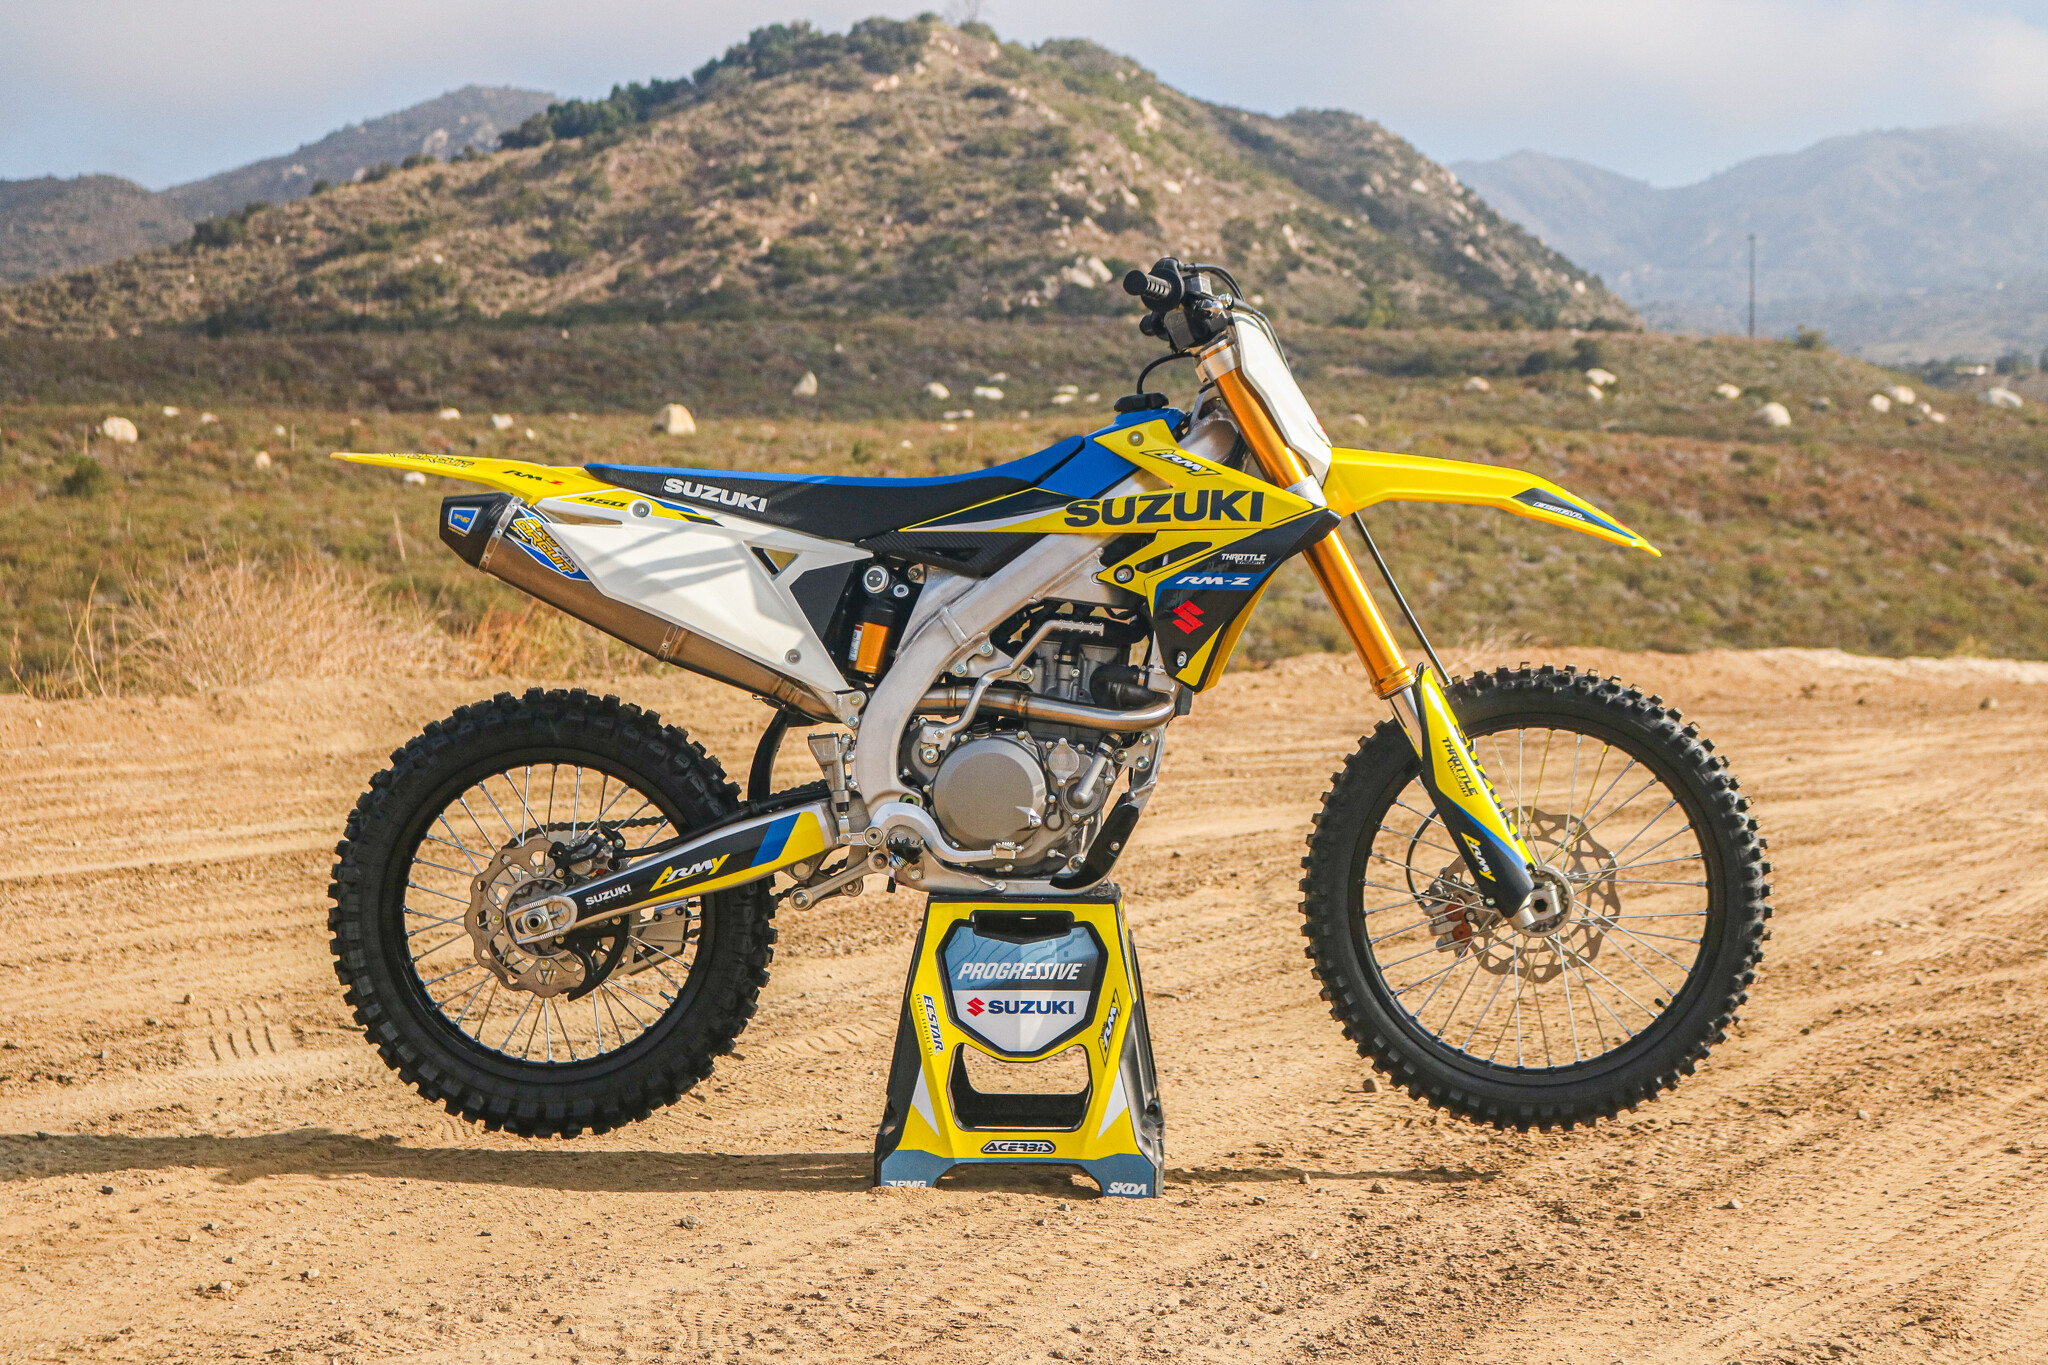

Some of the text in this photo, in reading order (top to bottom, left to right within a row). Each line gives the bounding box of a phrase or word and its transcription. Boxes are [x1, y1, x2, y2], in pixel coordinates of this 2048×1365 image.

[579, 496, 628, 507] 450
[663, 477, 768, 513] SUZUKI
[1064, 489, 1265, 527] SUZUKI
[514, 519, 575, 573] CIRCUIT
[1221, 553, 1267, 564] THROTTLE
[1176, 576, 1251, 585] RM-Z
[1442, 736, 1479, 796] THROTTLE
[585, 883, 632, 906] SUZUKI
[957, 962, 1083, 980] PROGRESSIVE
[988, 999, 1077, 1015] SUZUKI
[922, 994, 945, 1053] ECSTAR
[1107, 1182, 1148, 1195] SKDA
